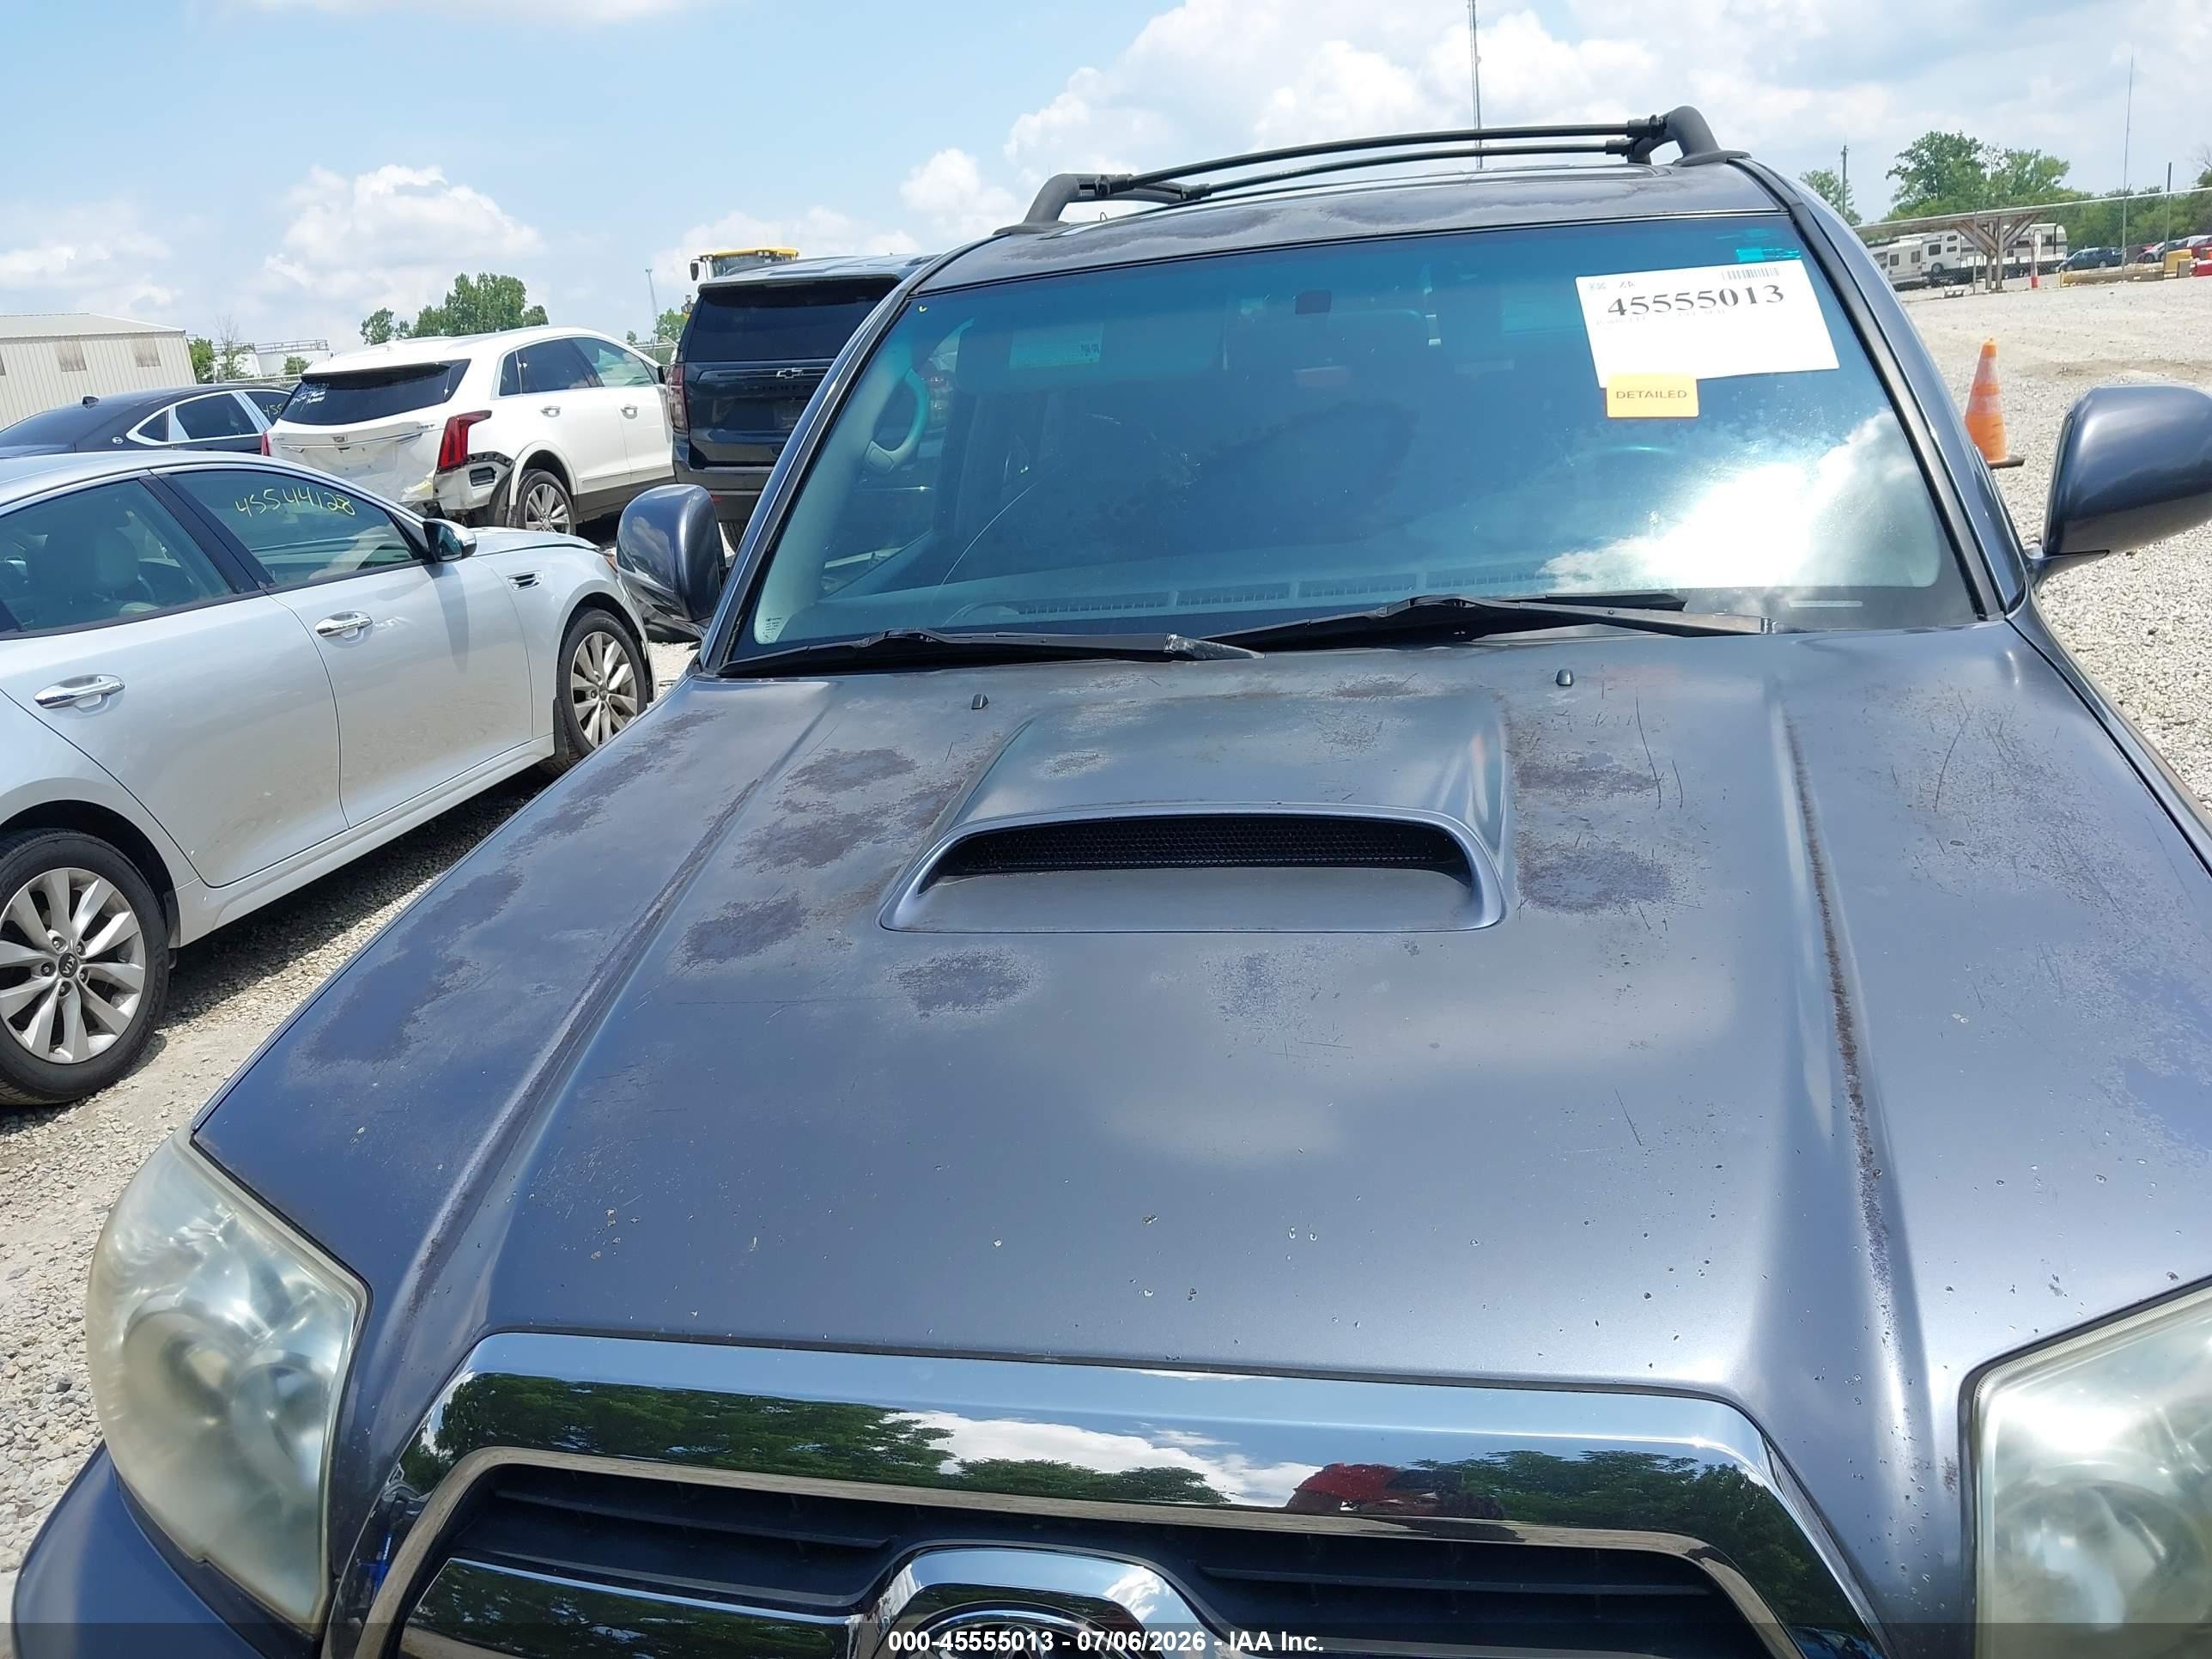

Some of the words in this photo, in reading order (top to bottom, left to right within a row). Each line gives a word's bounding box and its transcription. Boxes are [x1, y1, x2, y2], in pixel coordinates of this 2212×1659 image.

[1607, 284, 1784, 316] 45555013
[1616, 389, 1687, 399] DETAILED
[234, 486, 356, 517] 45544128
